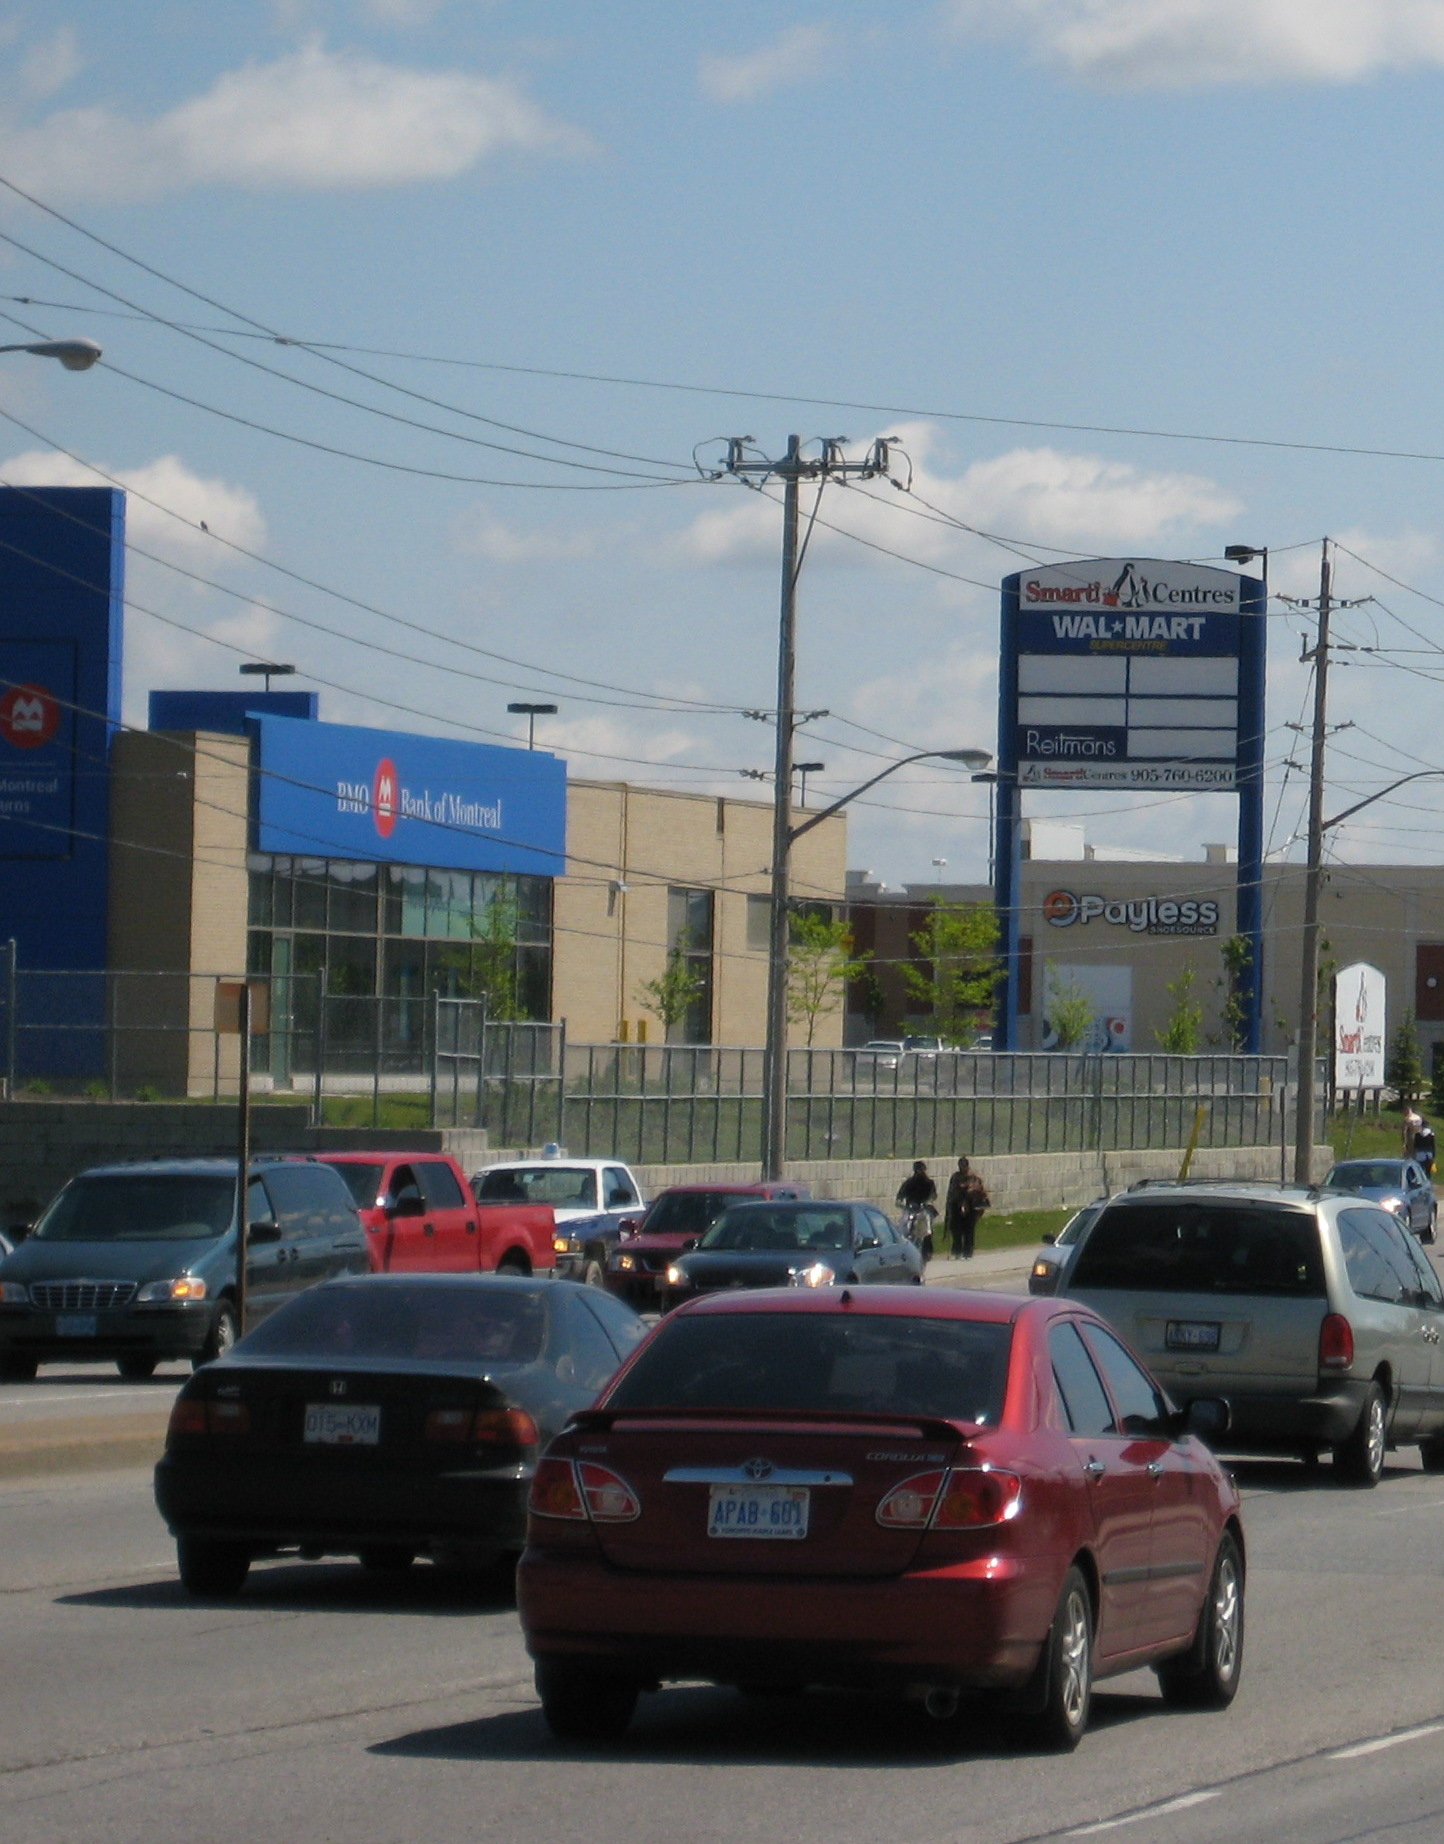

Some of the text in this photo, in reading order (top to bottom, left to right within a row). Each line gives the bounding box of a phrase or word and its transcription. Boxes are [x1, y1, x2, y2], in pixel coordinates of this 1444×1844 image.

[1153, 582, 1234, 604] Centres
[1026, 730, 1117, 756] Reitmans
[1131, 768, 1233, 783] 905-760-6200
[336, 781, 501, 829] BMO Bank of Montreal
[1080, 894, 1219, 932] Payless
